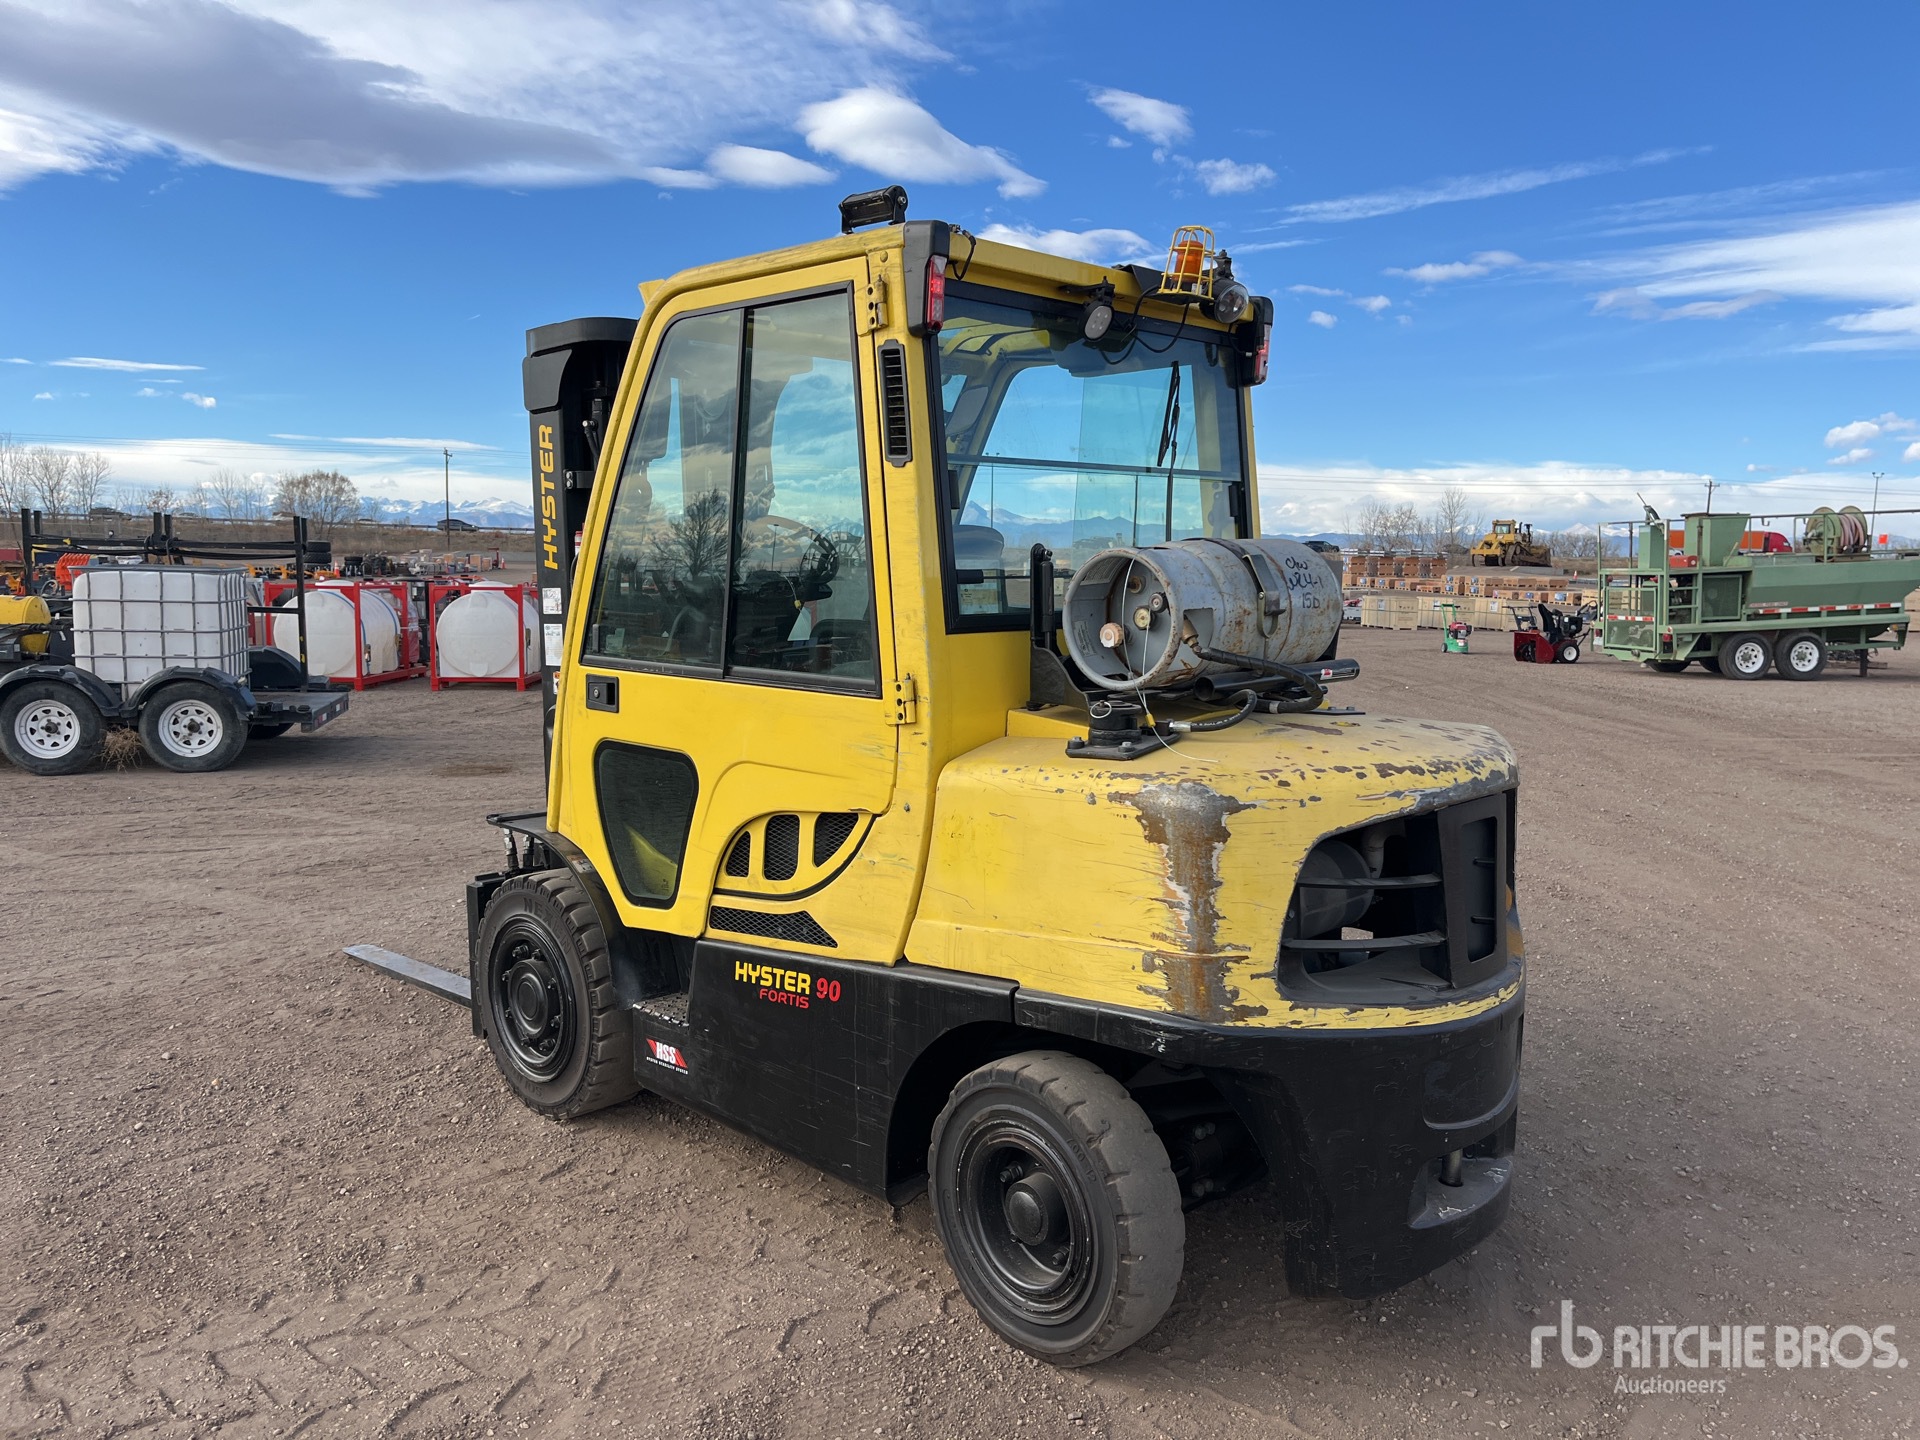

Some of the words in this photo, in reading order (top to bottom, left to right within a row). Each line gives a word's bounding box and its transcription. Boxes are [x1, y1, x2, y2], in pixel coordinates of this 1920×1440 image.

[539, 424, 558, 570] HYSTER
[735, 961, 811, 995] HYSTER
[816, 977, 842, 1002] 90
[759, 988, 809, 1009] FORTIS
[654, 1041, 678, 1065] HSS
